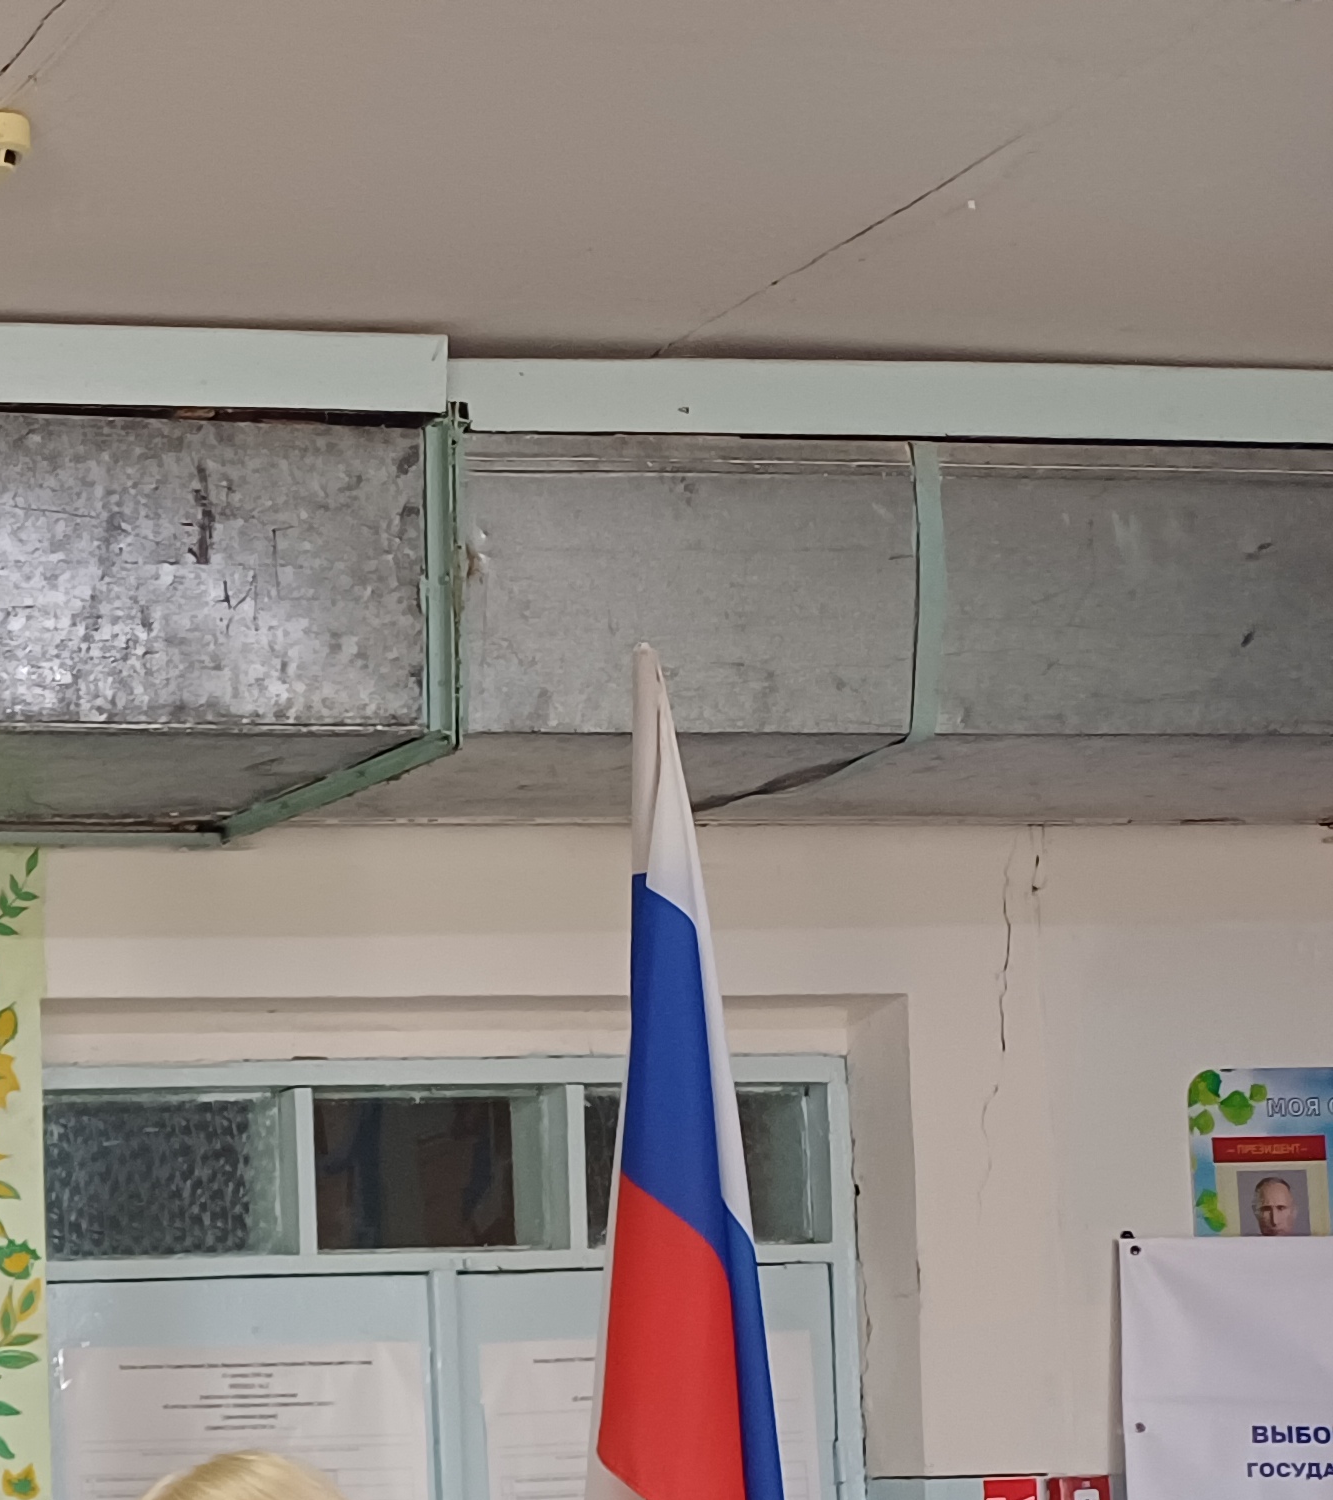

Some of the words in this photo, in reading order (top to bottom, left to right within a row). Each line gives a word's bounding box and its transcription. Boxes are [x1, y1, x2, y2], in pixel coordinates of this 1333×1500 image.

[1266, 1096, 1321, 1118] МОЯ
[1236, 1143, 1301, 1155] ПРЕЗИДЕНТ
[1251, 1425, 1333, 1445] ВЫБО
